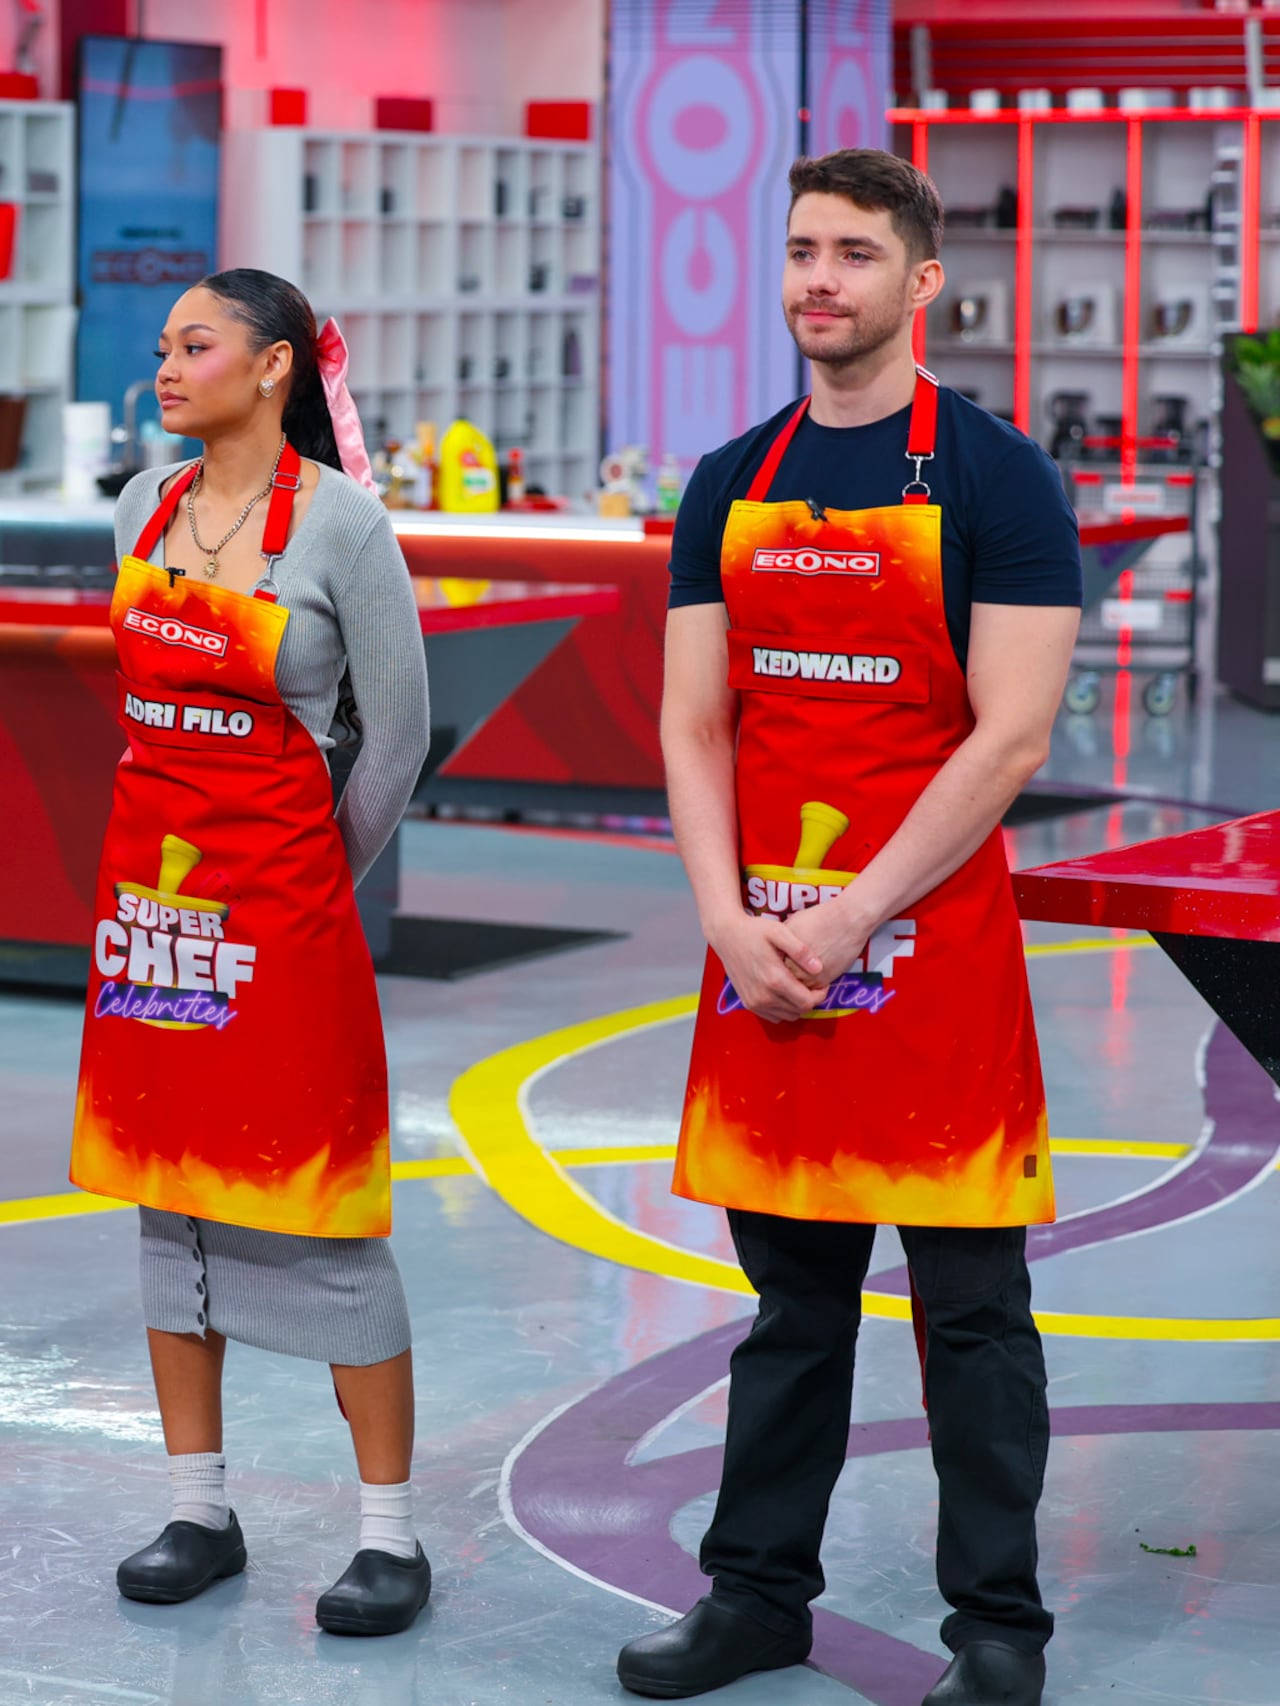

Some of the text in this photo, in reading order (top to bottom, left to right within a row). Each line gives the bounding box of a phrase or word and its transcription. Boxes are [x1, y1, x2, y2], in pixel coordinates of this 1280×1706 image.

[756, 552, 875, 571] ECONO
[126, 613, 222, 650] ECONO
[752, 647, 901, 684] KEDWARD
[124, 692, 253, 737] ADRI FILO
[116, 892, 224, 940] SUPER
[95, 919, 257, 1000] CHEF
[94, 980, 238, 1030] Celebrities
